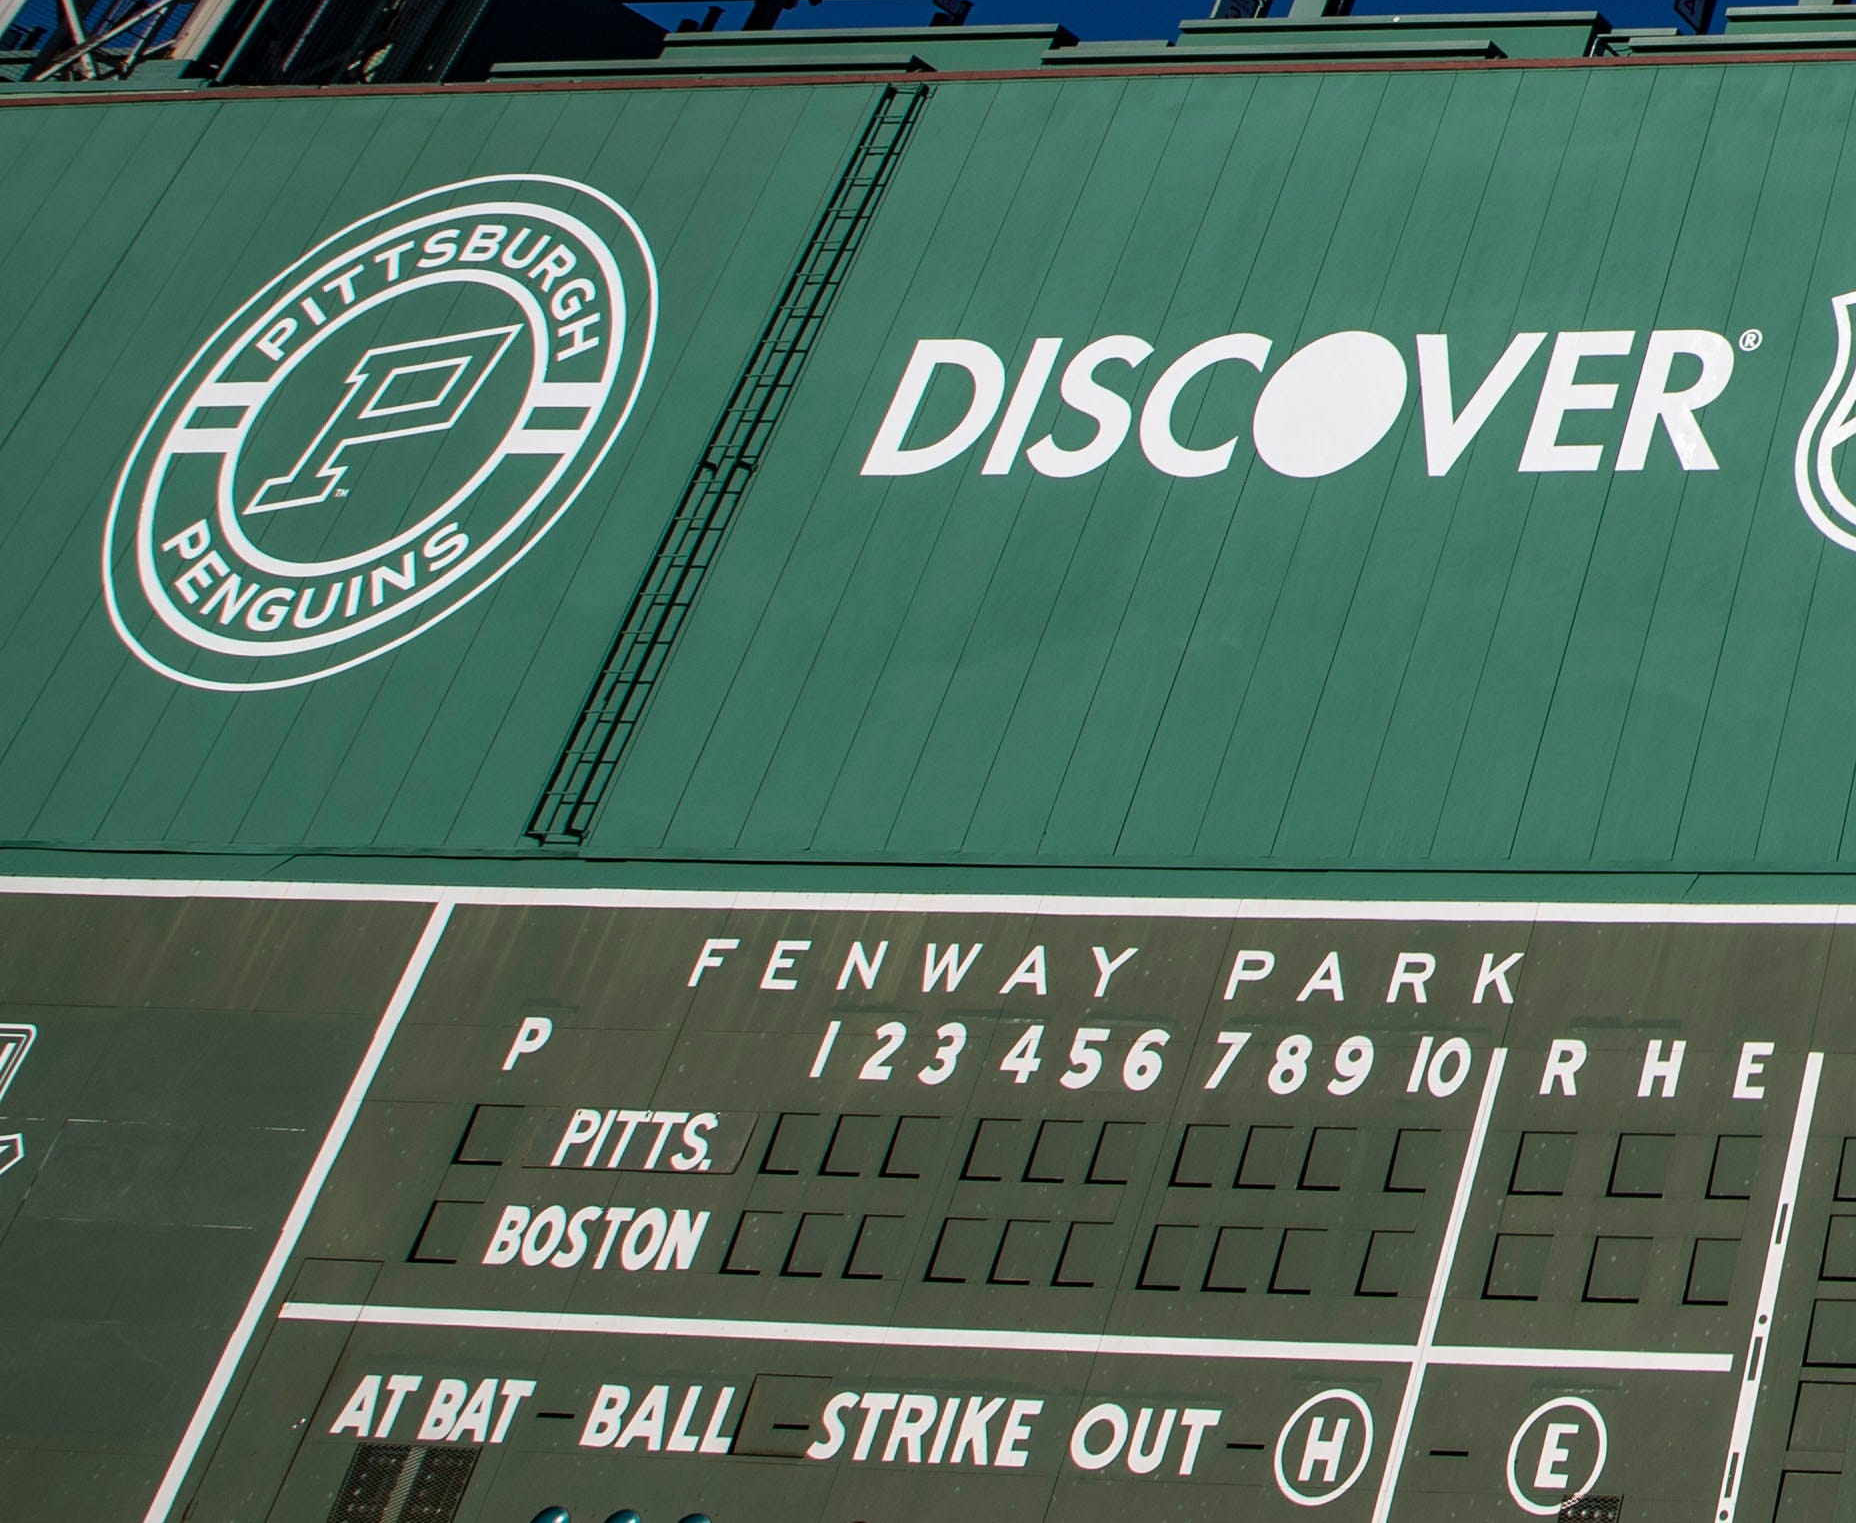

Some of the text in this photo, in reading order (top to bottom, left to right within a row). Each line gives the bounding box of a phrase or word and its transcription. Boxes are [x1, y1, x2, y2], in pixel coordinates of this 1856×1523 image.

[256, 224, 600, 363] PITTSBURGH
[162, 518, 471, 634] PENGUINS
[688, 939, 1524, 1003] FENWAY PARK
[503, 1017, 1774, 1099] P 1 2 3 4 5 6 7 8 9 10 R H E
[551, 1109, 717, 1170] PITTS.
[482, 1206, 710, 1270] BOSTON
[330, 1375, 1578, 1488] AT BAT BALL STRIKE OUT H E
